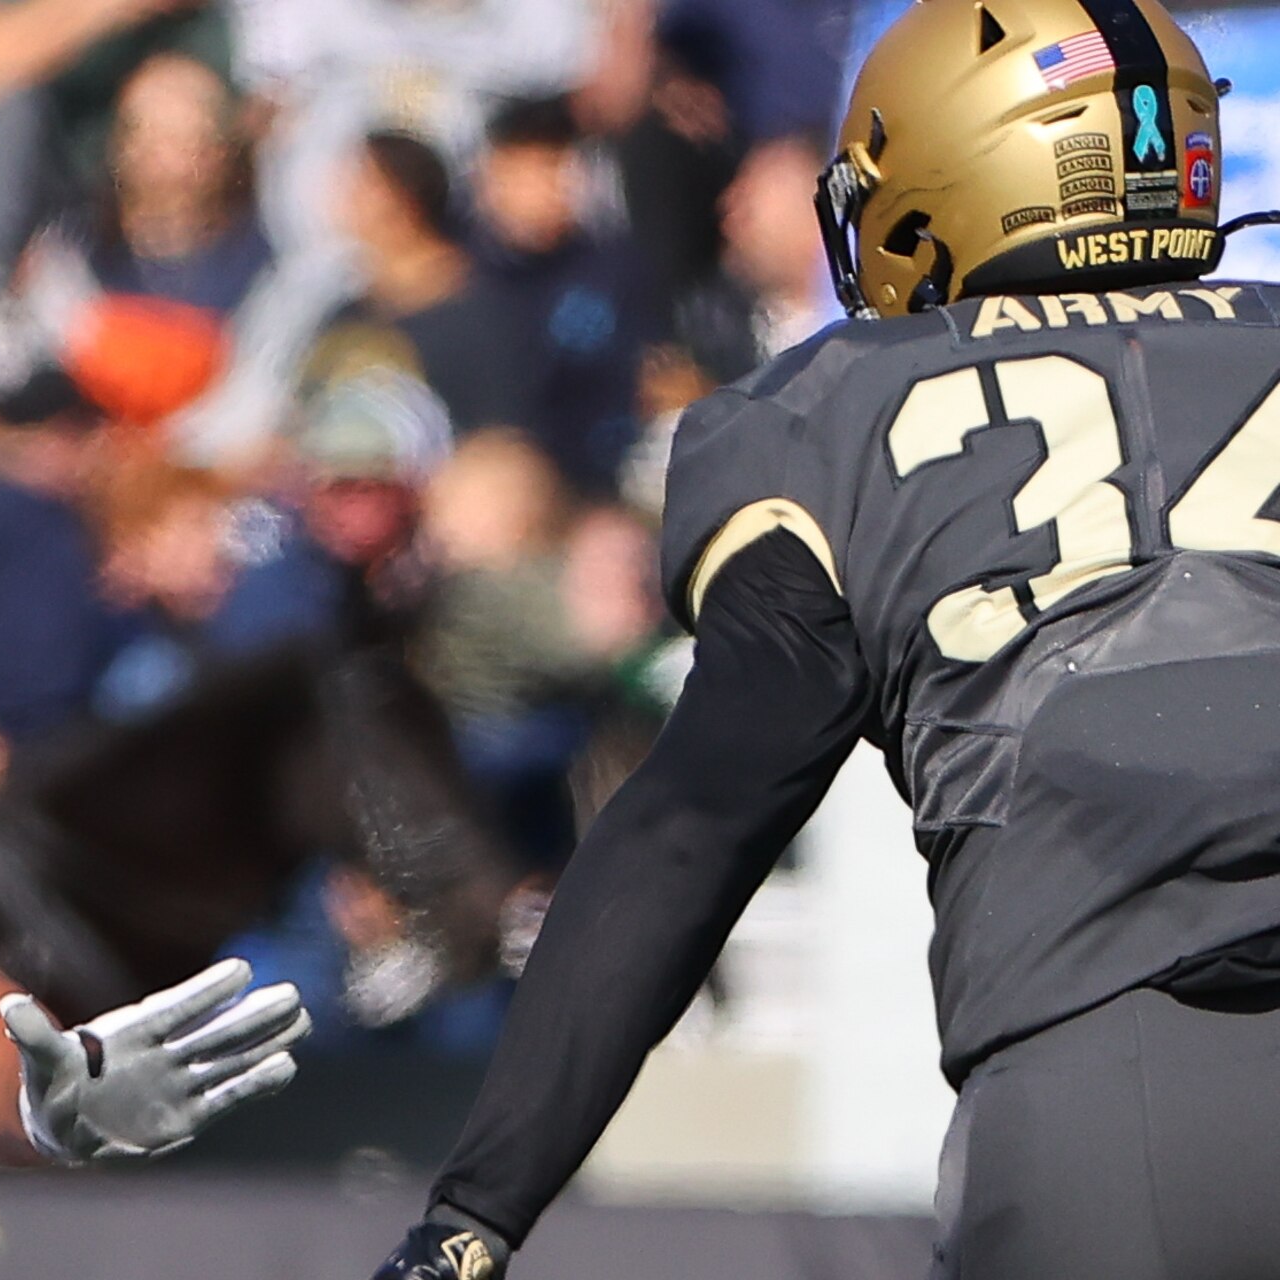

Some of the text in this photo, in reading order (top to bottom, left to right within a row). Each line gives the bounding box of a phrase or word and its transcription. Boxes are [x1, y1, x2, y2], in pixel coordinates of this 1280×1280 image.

[1056, 228, 1216, 270] WEST POINT
[970, 287, 1242, 338] ARMY
